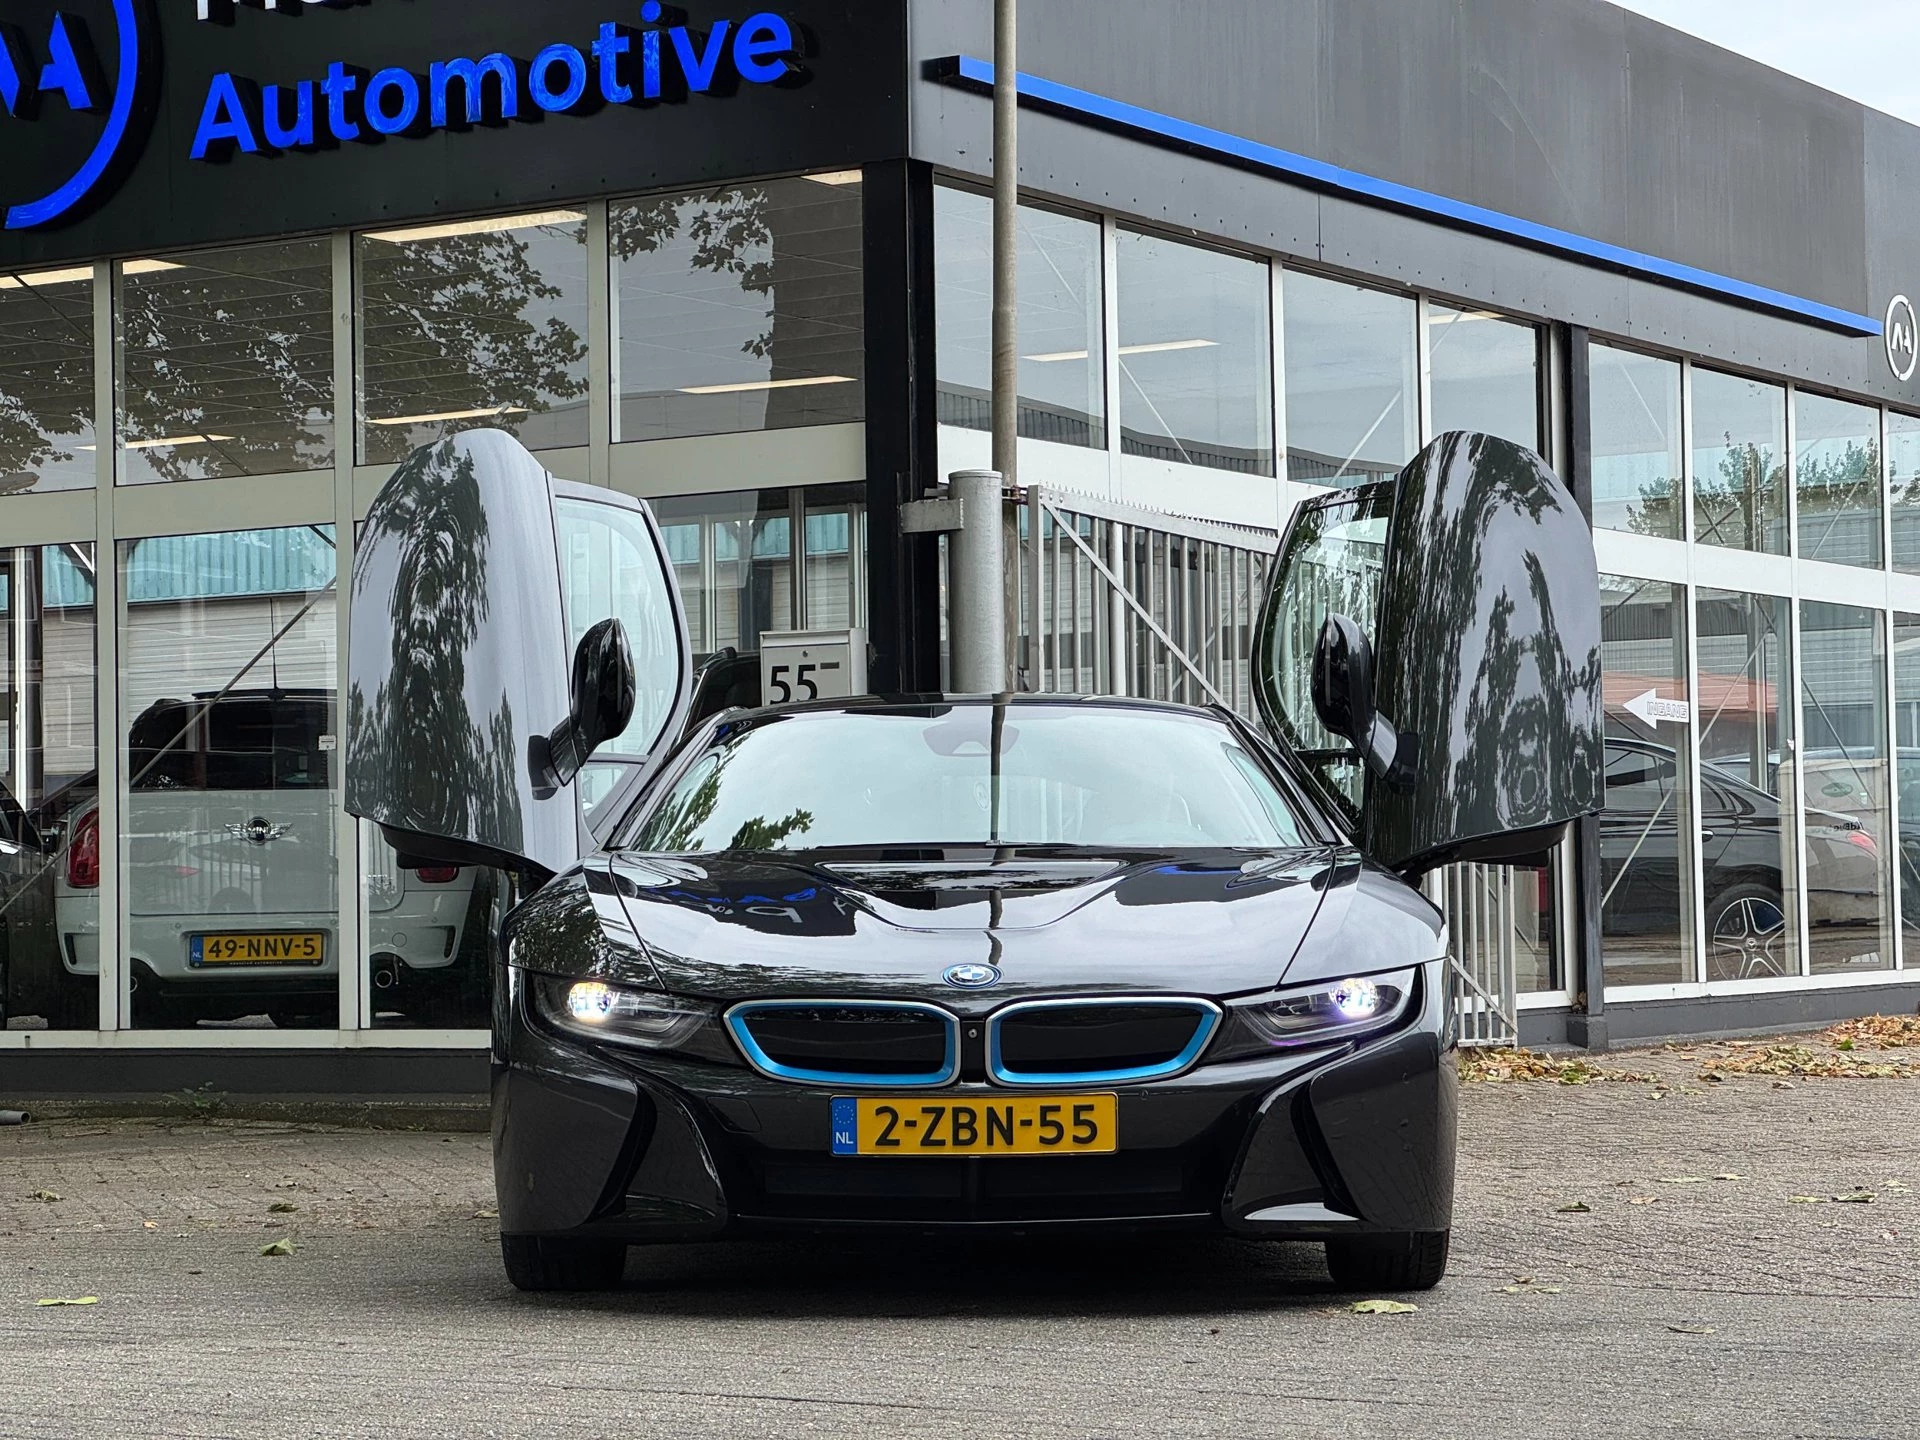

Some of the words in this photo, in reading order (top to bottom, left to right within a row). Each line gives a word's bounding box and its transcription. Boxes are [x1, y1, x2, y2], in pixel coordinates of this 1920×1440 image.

[190, 0, 793, 160] Automotive
[770, 664, 818, 704] 55
[1646, 701, 1688, 719] INGANG
[208, 937, 316, 958] 49-NNV-5
[835, 1132, 853, 1145] NL
[874, 1104, 1098, 1147] 2-ZBN-55
